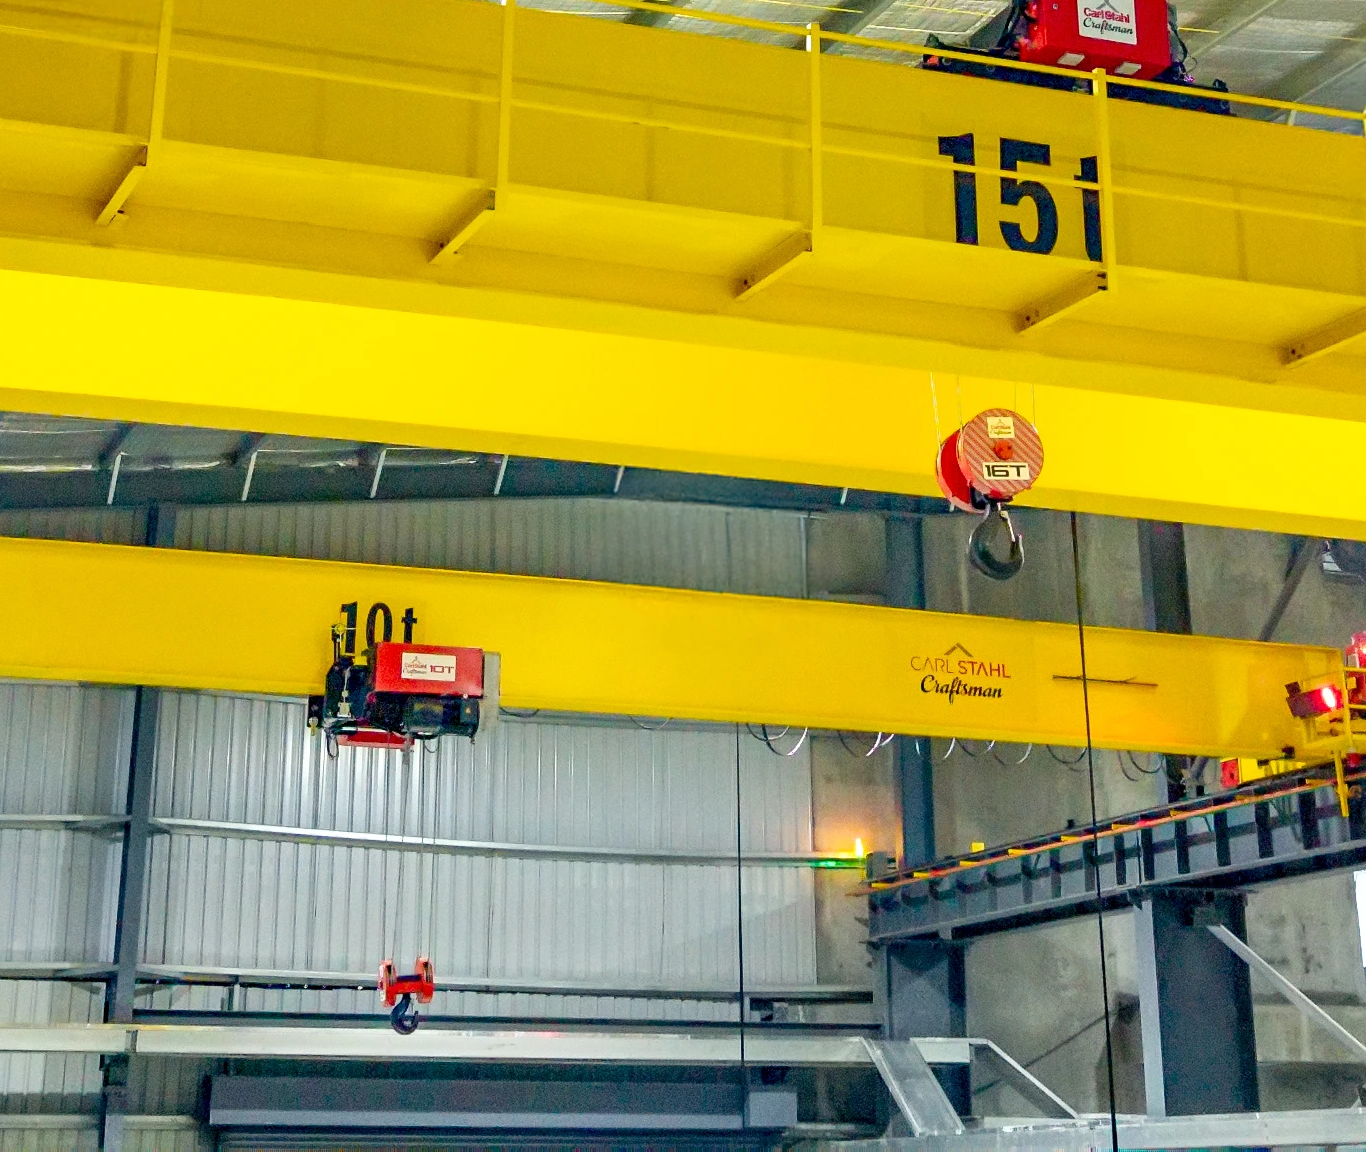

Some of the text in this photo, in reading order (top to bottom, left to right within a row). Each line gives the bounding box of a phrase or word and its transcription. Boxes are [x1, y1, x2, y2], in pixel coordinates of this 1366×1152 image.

[1083, 17, 1134, 35] Craftsman
[910, 656, 1011, 679] CARL STAHL
[920, 674, 1004, 705] Craftsman
